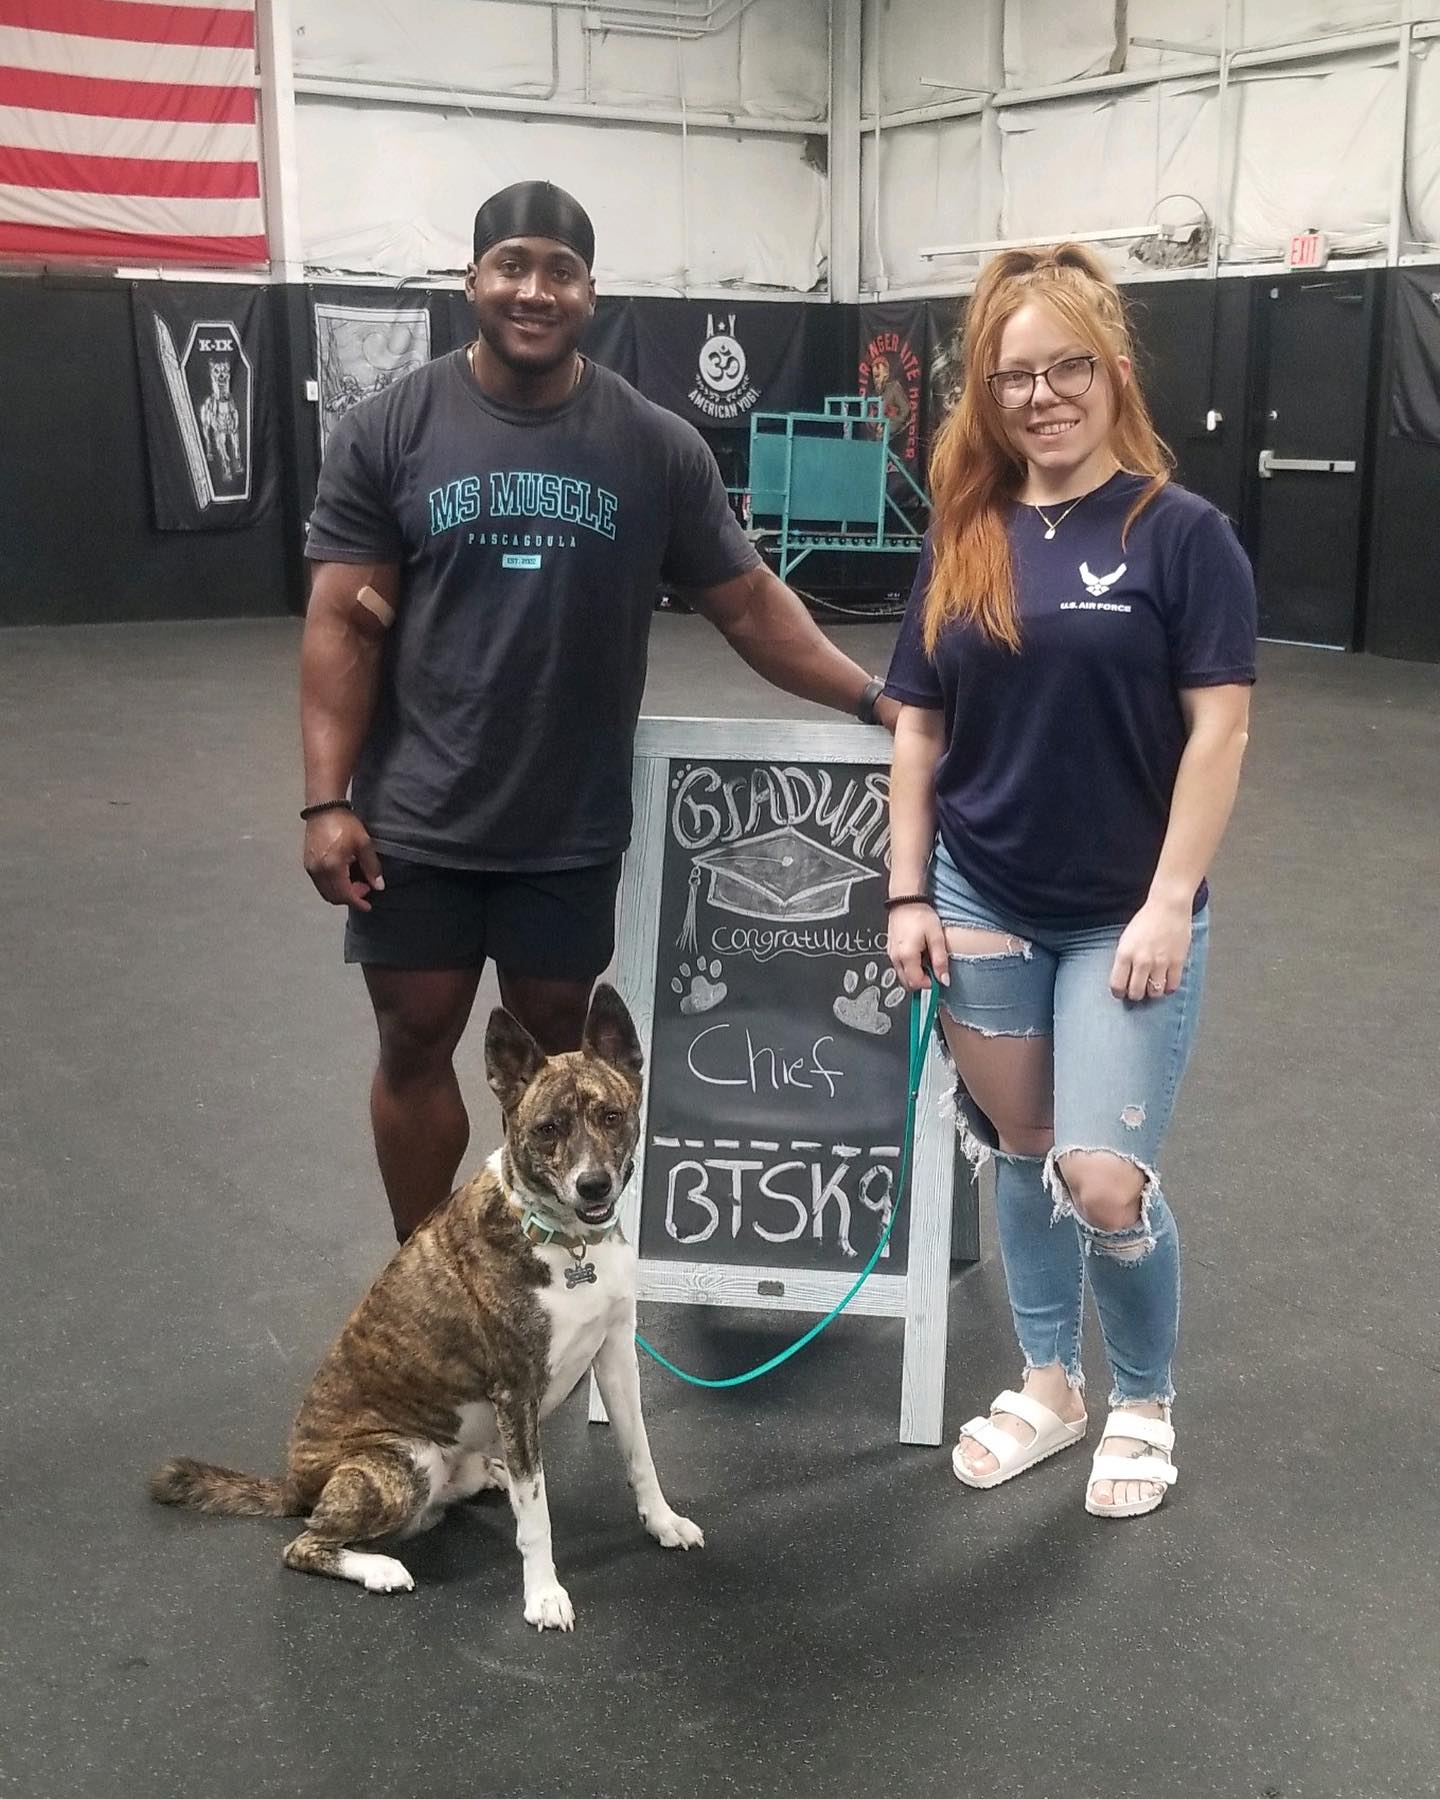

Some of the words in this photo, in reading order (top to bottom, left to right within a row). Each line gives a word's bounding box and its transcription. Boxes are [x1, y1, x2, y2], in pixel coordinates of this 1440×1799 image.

[1290, 236, 1318, 266] EXIT
[199, 339, 234, 351] K-IX
[688, 389, 739, 419] AMERICAN
[737, 388, 761, 413] YOGI
[429, 475, 481, 537] MS
[490, 471, 618, 542] MUSCLE
[468, 533, 576, 548] PASCAGOULA
[1060, 601, 1078, 610] U.S.
[1079, 602, 1097, 611] AIR
[1097, 602, 1132, 613] FORCE
[687, 1023, 844, 1098] Chief
[664, 1157, 893, 1258] BTSK9
